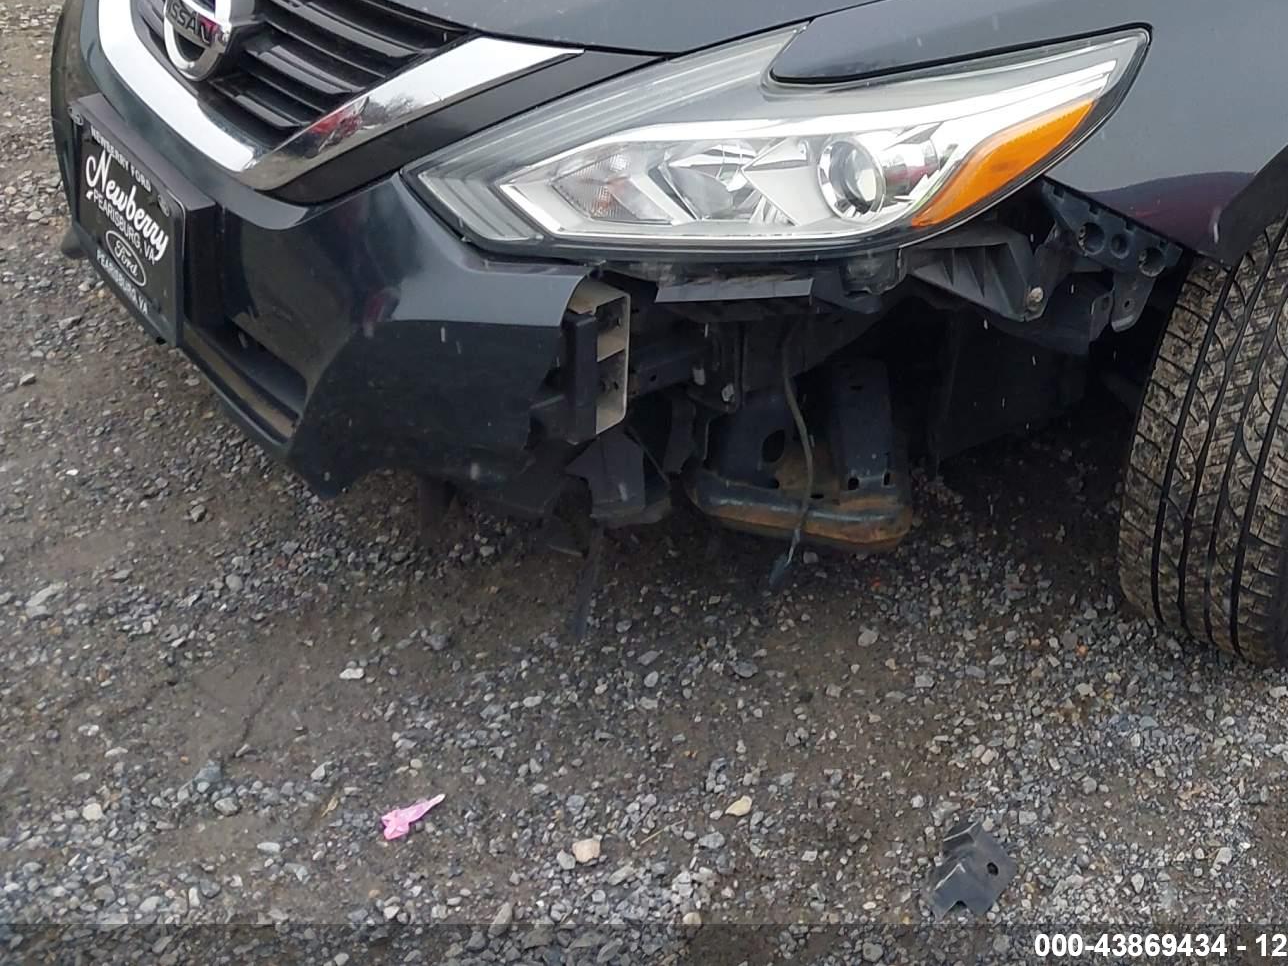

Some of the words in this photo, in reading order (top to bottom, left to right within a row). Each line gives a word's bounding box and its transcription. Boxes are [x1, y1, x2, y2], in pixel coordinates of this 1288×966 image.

[90, 124, 129, 171] NEWBERRY
[130, 164, 152, 193] FORD
[85, 147, 169, 262] Newberry
[114, 240, 138, 277] Ford
[143, 240, 155, 266] VA
